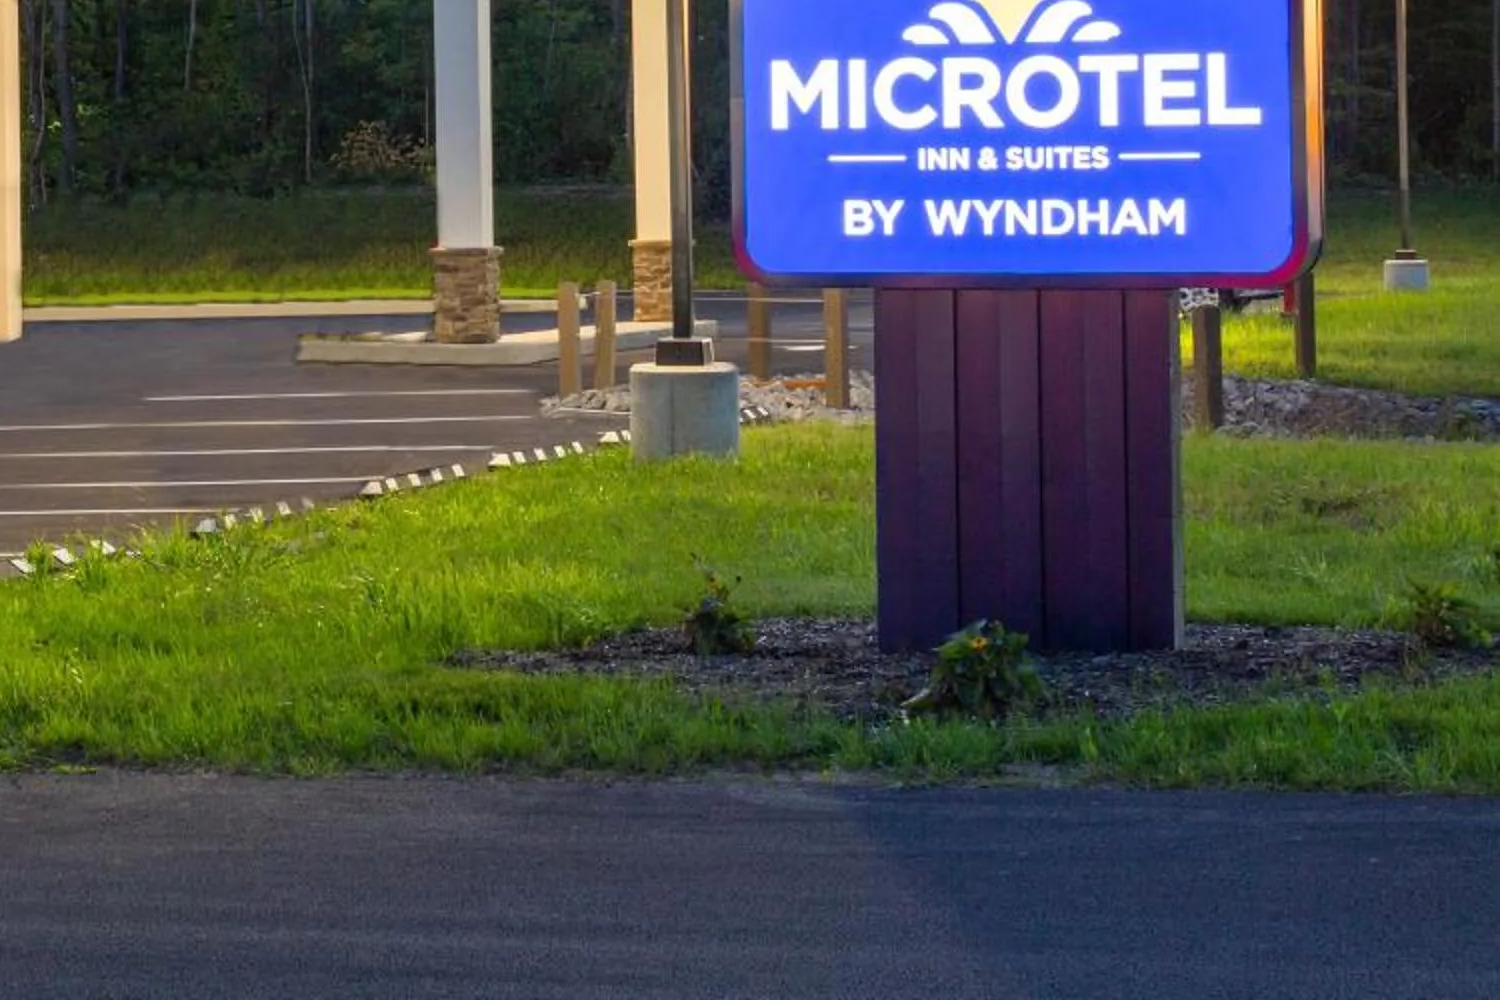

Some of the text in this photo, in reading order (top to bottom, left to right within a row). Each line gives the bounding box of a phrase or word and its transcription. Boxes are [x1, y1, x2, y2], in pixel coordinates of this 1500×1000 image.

[770, 52, 1262, 131] MICROTEL
[917, 145, 1110, 171] INN & SUITES
[843, 198, 1186, 236] BY WYNDHAM
